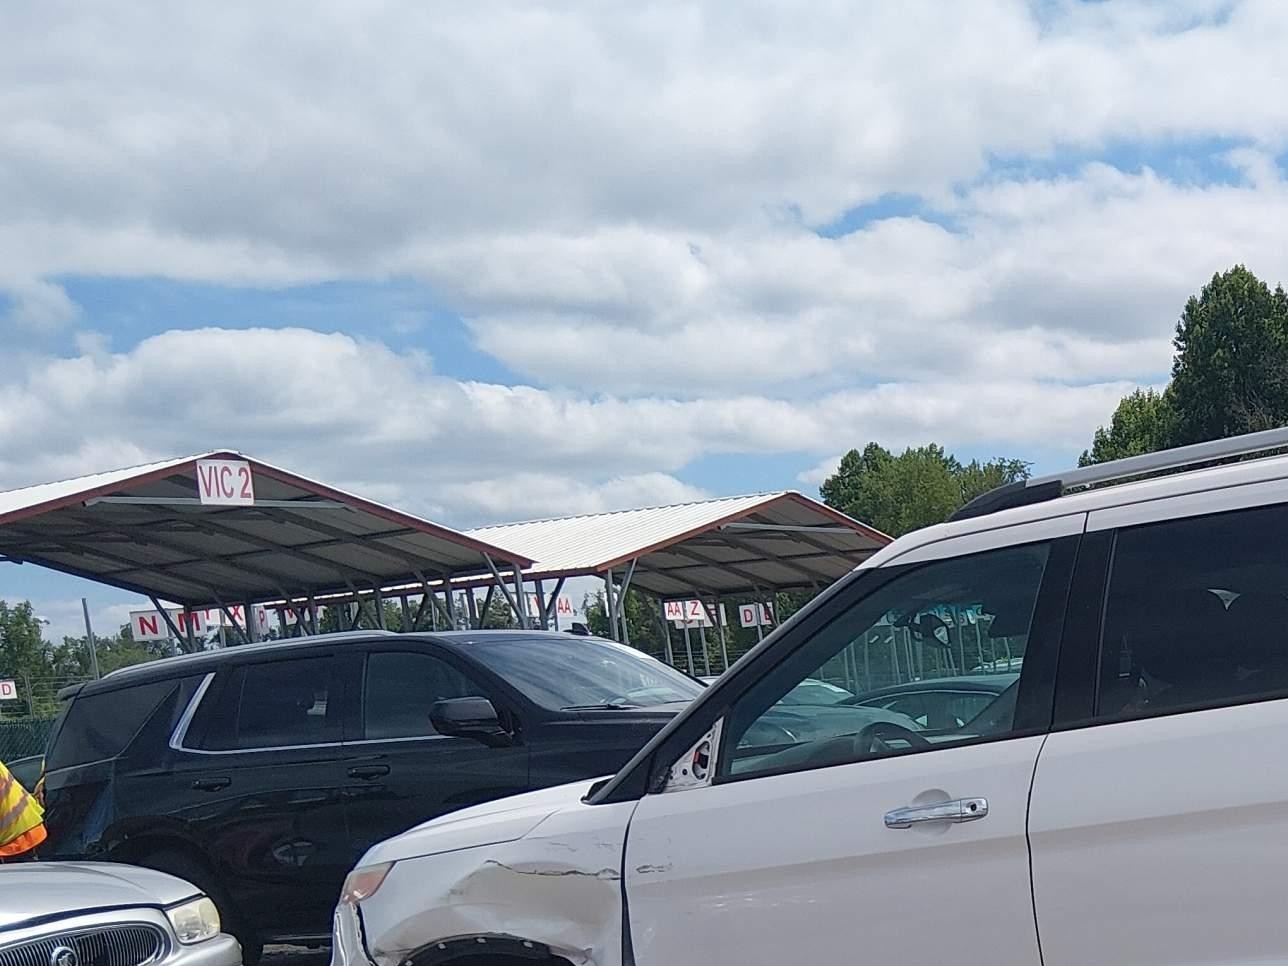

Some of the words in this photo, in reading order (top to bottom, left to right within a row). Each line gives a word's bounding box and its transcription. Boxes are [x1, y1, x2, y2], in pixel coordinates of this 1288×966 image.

[199, 465, 234, 499] VIC
[238, 466, 252, 499] 2
[557, 598, 572, 614] AA
[667, 601, 682, 616] AA
[690, 601, 700, 616] Z
[743, 608, 753, 623] D
[138, 615, 159, 636] N
[1, 683, 12, 696] D
